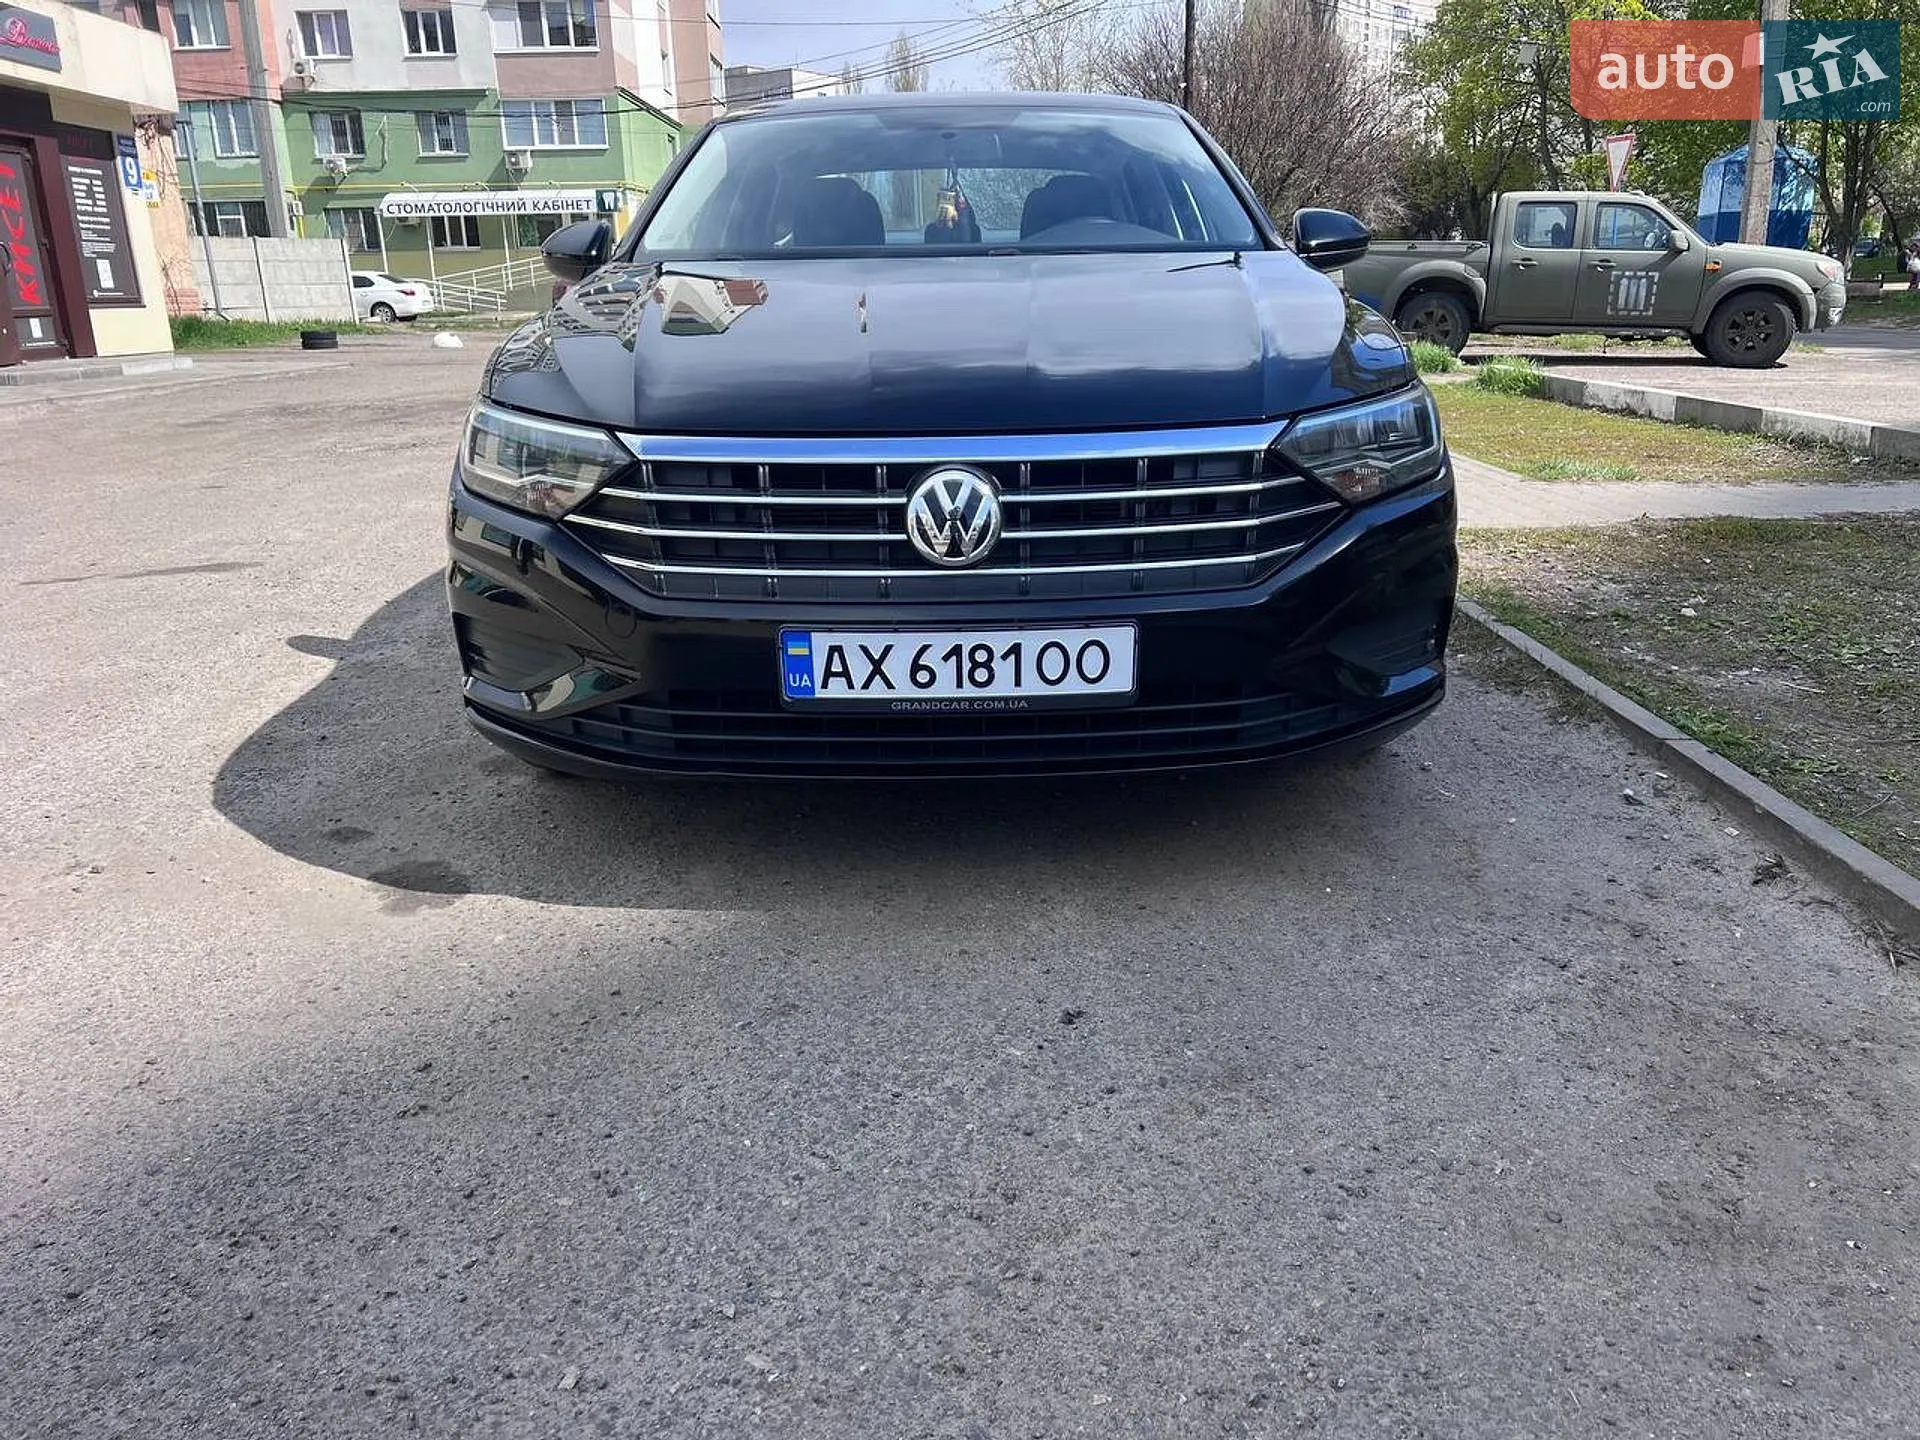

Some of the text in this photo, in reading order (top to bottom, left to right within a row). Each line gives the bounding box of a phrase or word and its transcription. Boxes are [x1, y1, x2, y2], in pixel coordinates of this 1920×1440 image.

[125, 156, 138, 186] 9
[386, 198, 592, 215] СТОМАТОЛОГІЧНИЙ КАБІНЕТ
[820, 644, 897, 690] AX
[908, 642, 1023, 690] 6181
[788, 674, 812, 688] UA
[890, 699, 1029, 711] GRANDCAR.COM.UA
